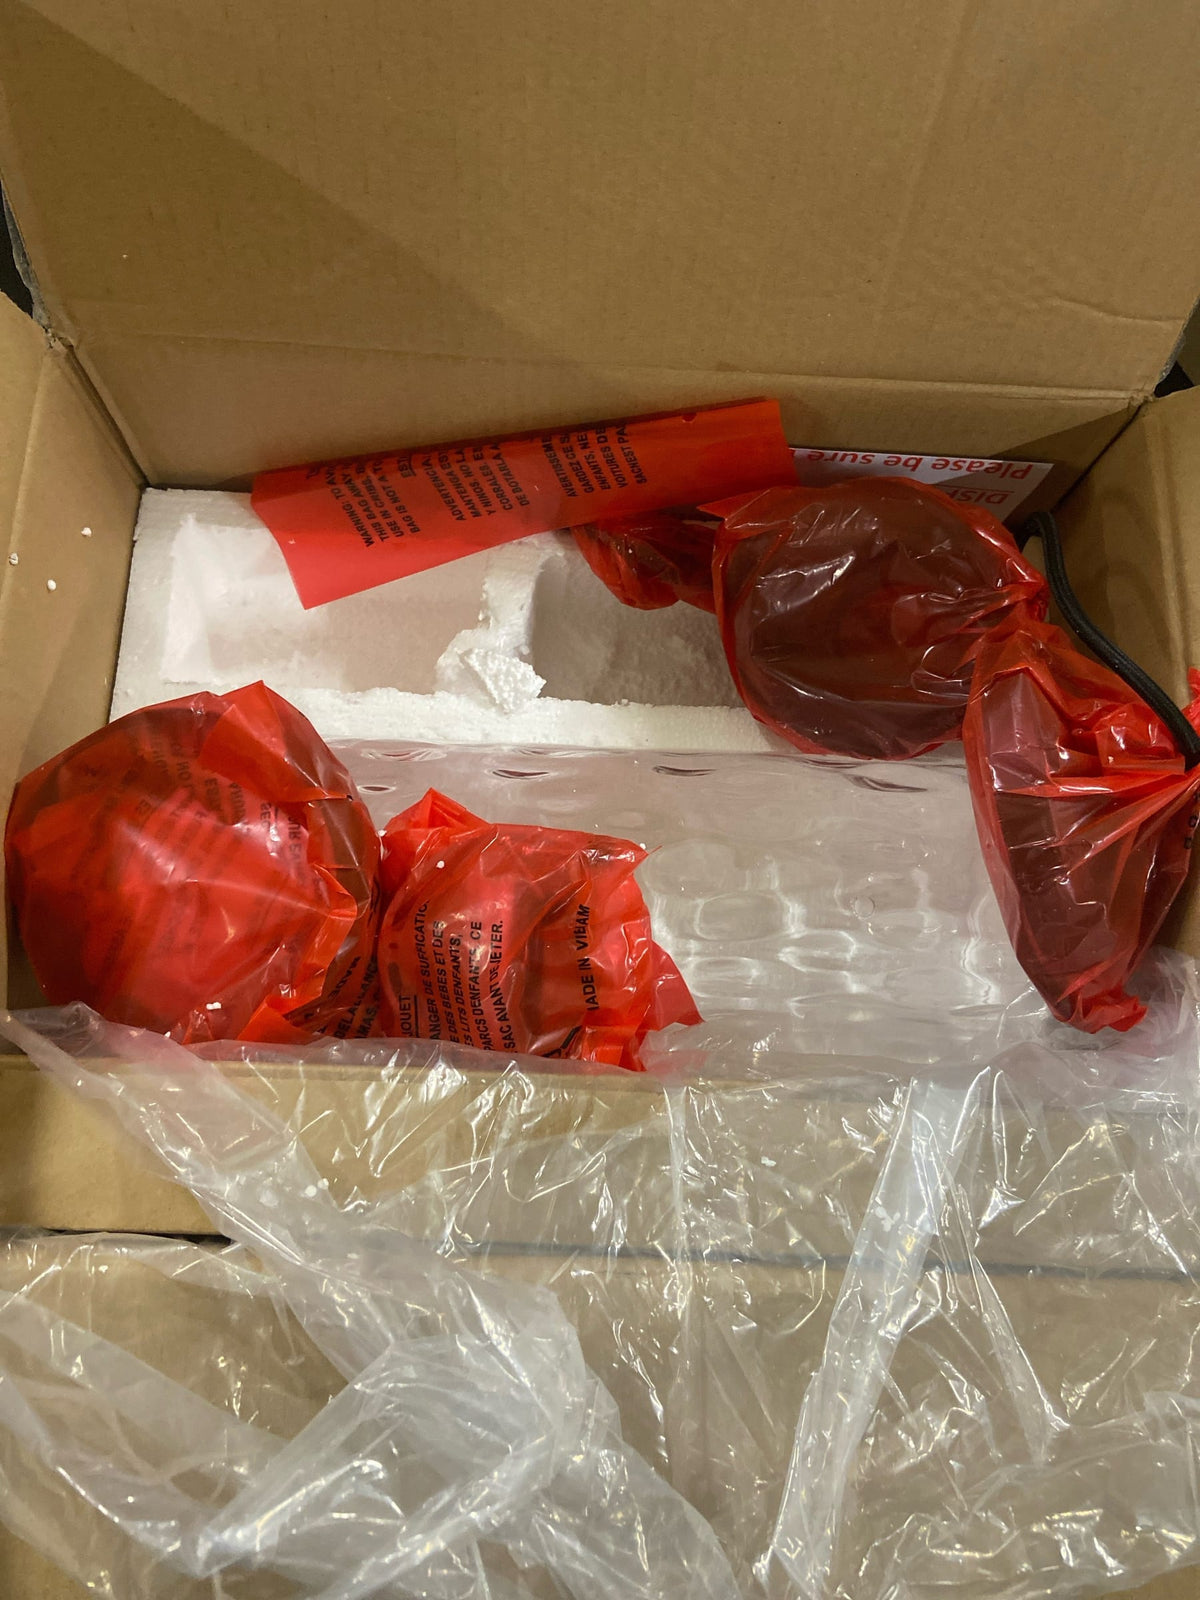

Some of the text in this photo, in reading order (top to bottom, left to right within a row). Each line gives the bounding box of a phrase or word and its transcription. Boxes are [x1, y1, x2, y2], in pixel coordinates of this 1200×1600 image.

[562, 445, 576, 459] CE
[576, 433, 611, 490] ENFANTS, NE
[620, 444, 647, 484] SACNEST
[807, 450, 1032, 479] Please be sure
[377, 474, 388, 482] A
[459, 463, 473, 477] NO
[492, 452, 522, 492] BOTARLA
[539, 435, 577, 497] AVERTISSEME
[568, 460, 594, 493] GARDEZ
[600, 445, 628, 488] VOITURES
[330, 487, 345, 499] TO
[381, 485, 400, 504] NOT
[437, 450, 481, 517] MANTENGA EST
[340, 473, 389, 541] THIS BAG AWAY
[395, 504, 407, 513] IS
[516, 493, 529, 505] DE
[341, 499, 374, 547] WARNING:
[379, 509, 391, 519] IN
[402, 515, 420, 532] BAG
[386, 519, 404, 537] USE
[432, 920, 443, 947] DES
[470, 921, 481, 940] CE
[433, 949, 445, 964] ET
[450, 934, 464, 1004] DENFANTS,
[577, 958, 591, 970] IN
[414, 900, 440, 1040] ANGER DE SUFFICATIO
[489, 965, 499, 981] DE
[436, 968, 451, 1007] BEBES
[489, 982, 509, 1021] AVANT
[399, 994, 412, 1036] JOUET
[444, 1010, 457, 1033] DES
[457, 1007, 470, 1032] LITS
[475, 1018, 495, 1050] PARCS
[499, 1024, 515, 1048] SAC
